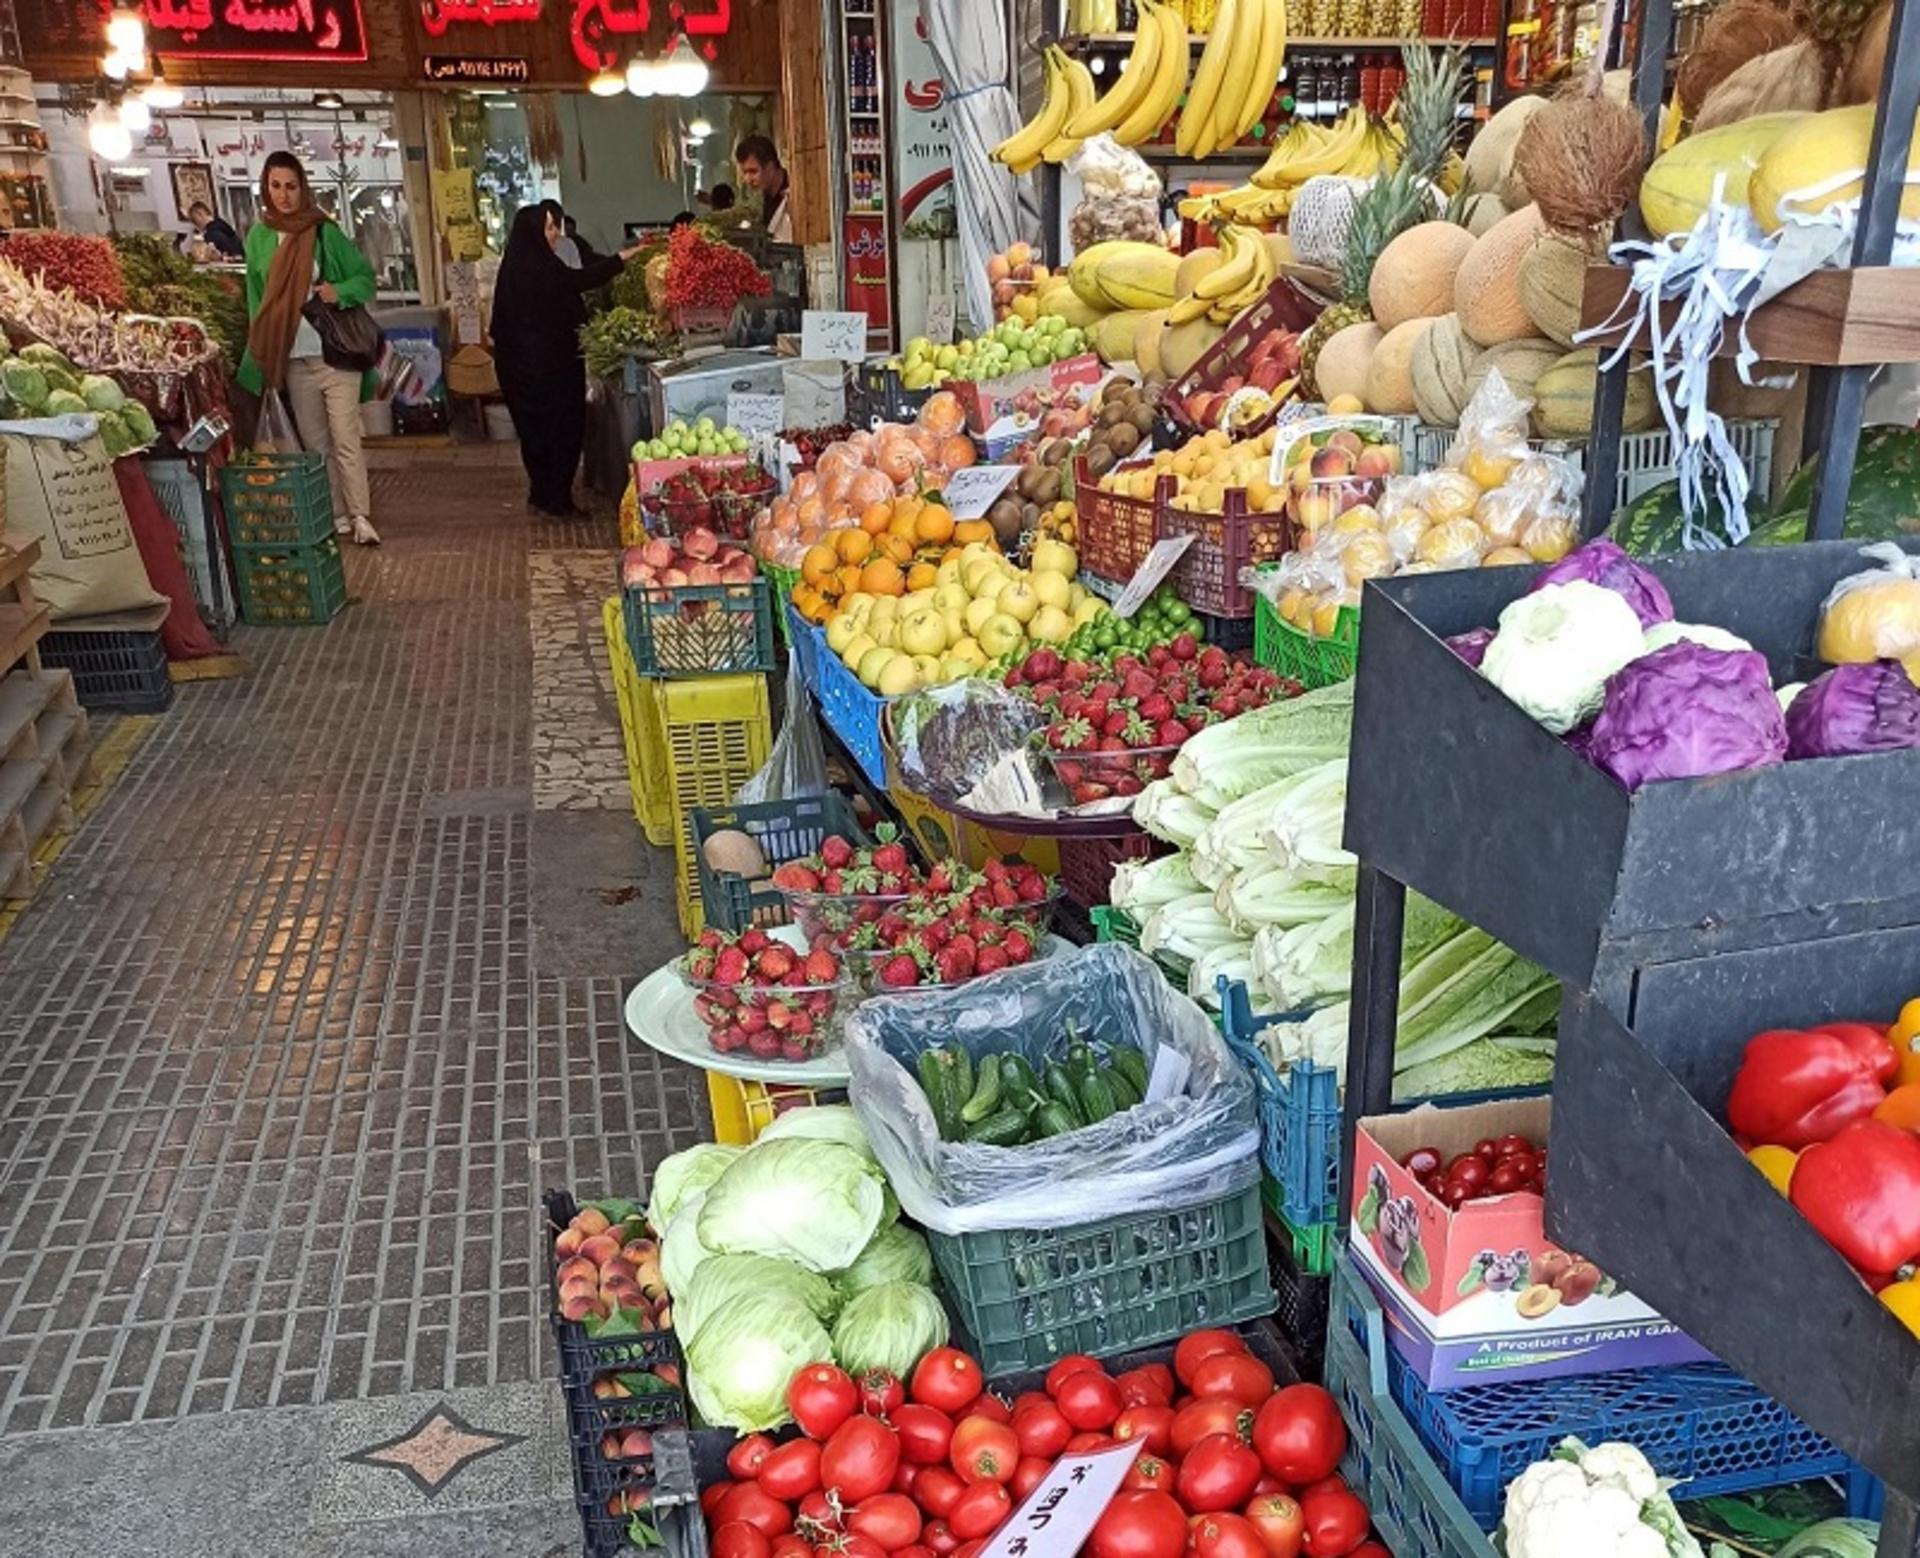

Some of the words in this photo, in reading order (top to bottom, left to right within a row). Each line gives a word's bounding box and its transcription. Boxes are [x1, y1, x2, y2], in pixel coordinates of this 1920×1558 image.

[1478, 1342, 1491, 1352] A
[1497, 1335, 1568, 1351] Product
[1573, 1333, 1591, 1344] of
[1596, 1327, 1641, 1342] IRAN
